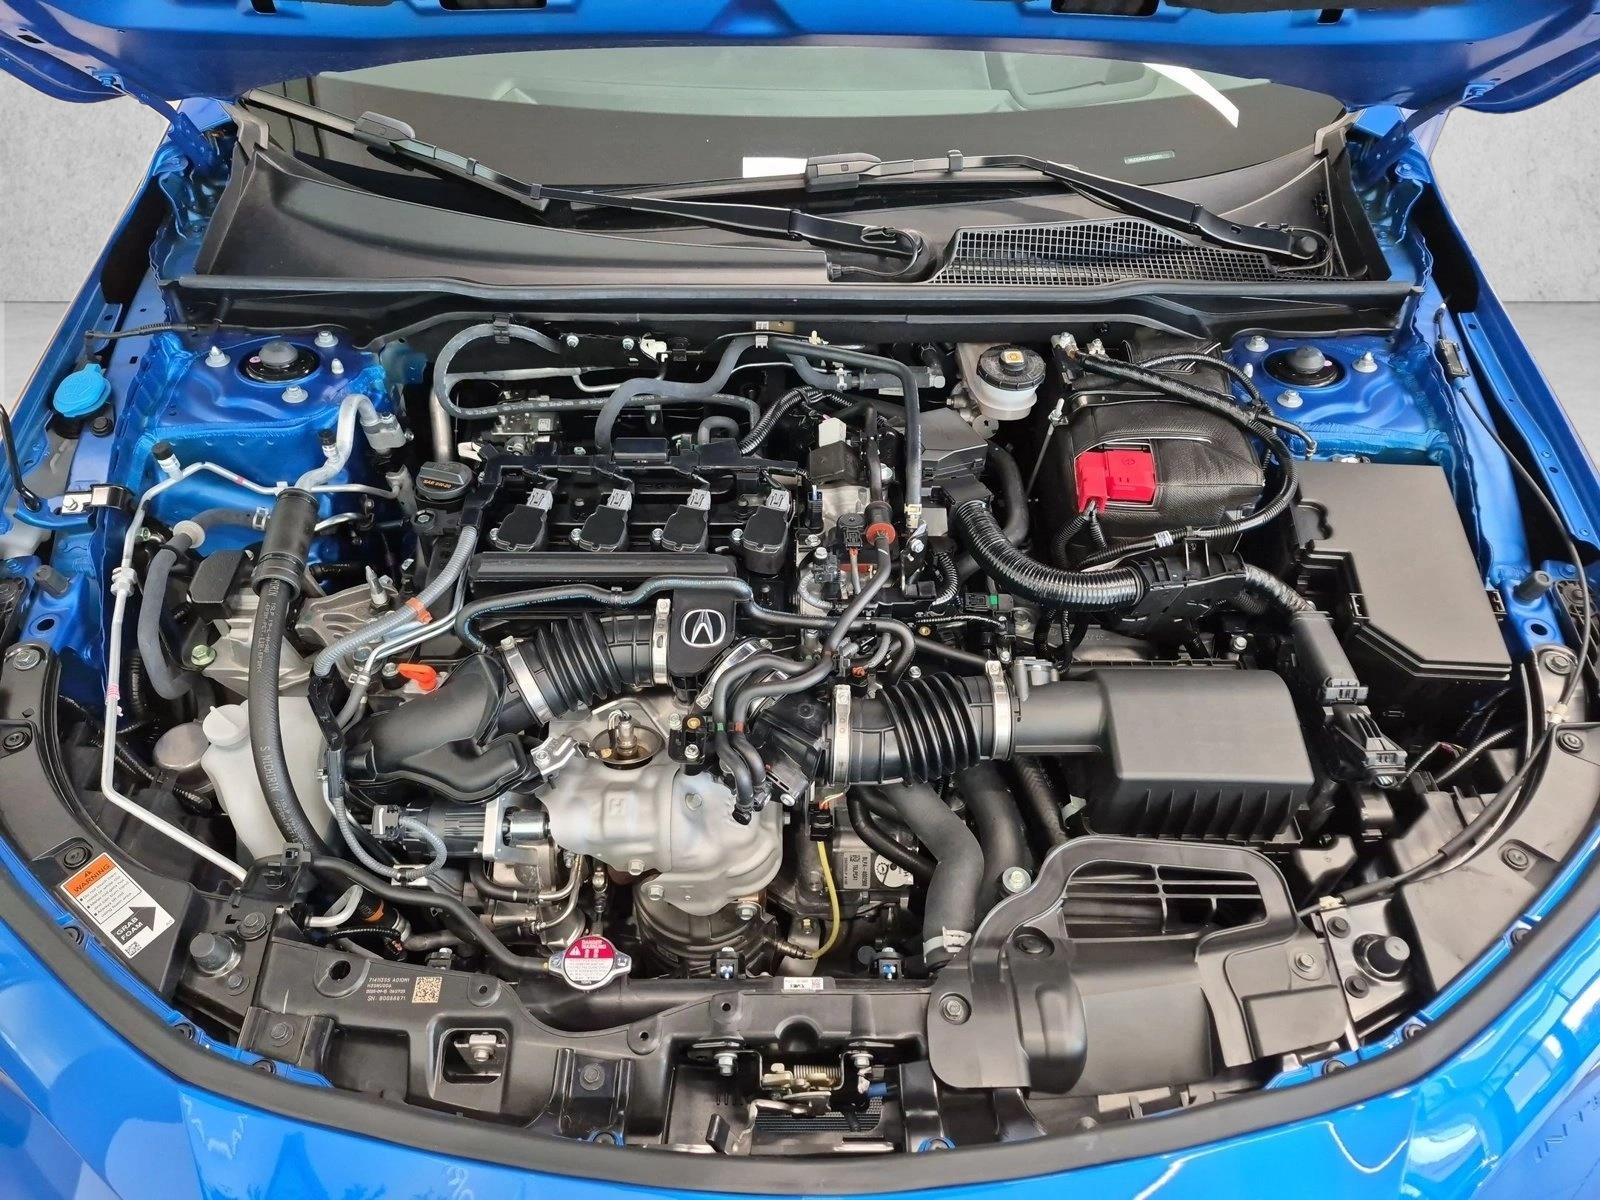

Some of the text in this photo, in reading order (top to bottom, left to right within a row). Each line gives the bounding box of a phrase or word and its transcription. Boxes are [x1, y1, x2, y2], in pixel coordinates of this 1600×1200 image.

[261, 754, 281, 792] NICHIRIN
[73, 864, 110, 893] WARNING
[116, 916, 138, 936] GRAB
[120, 922, 144, 941] FOAM
